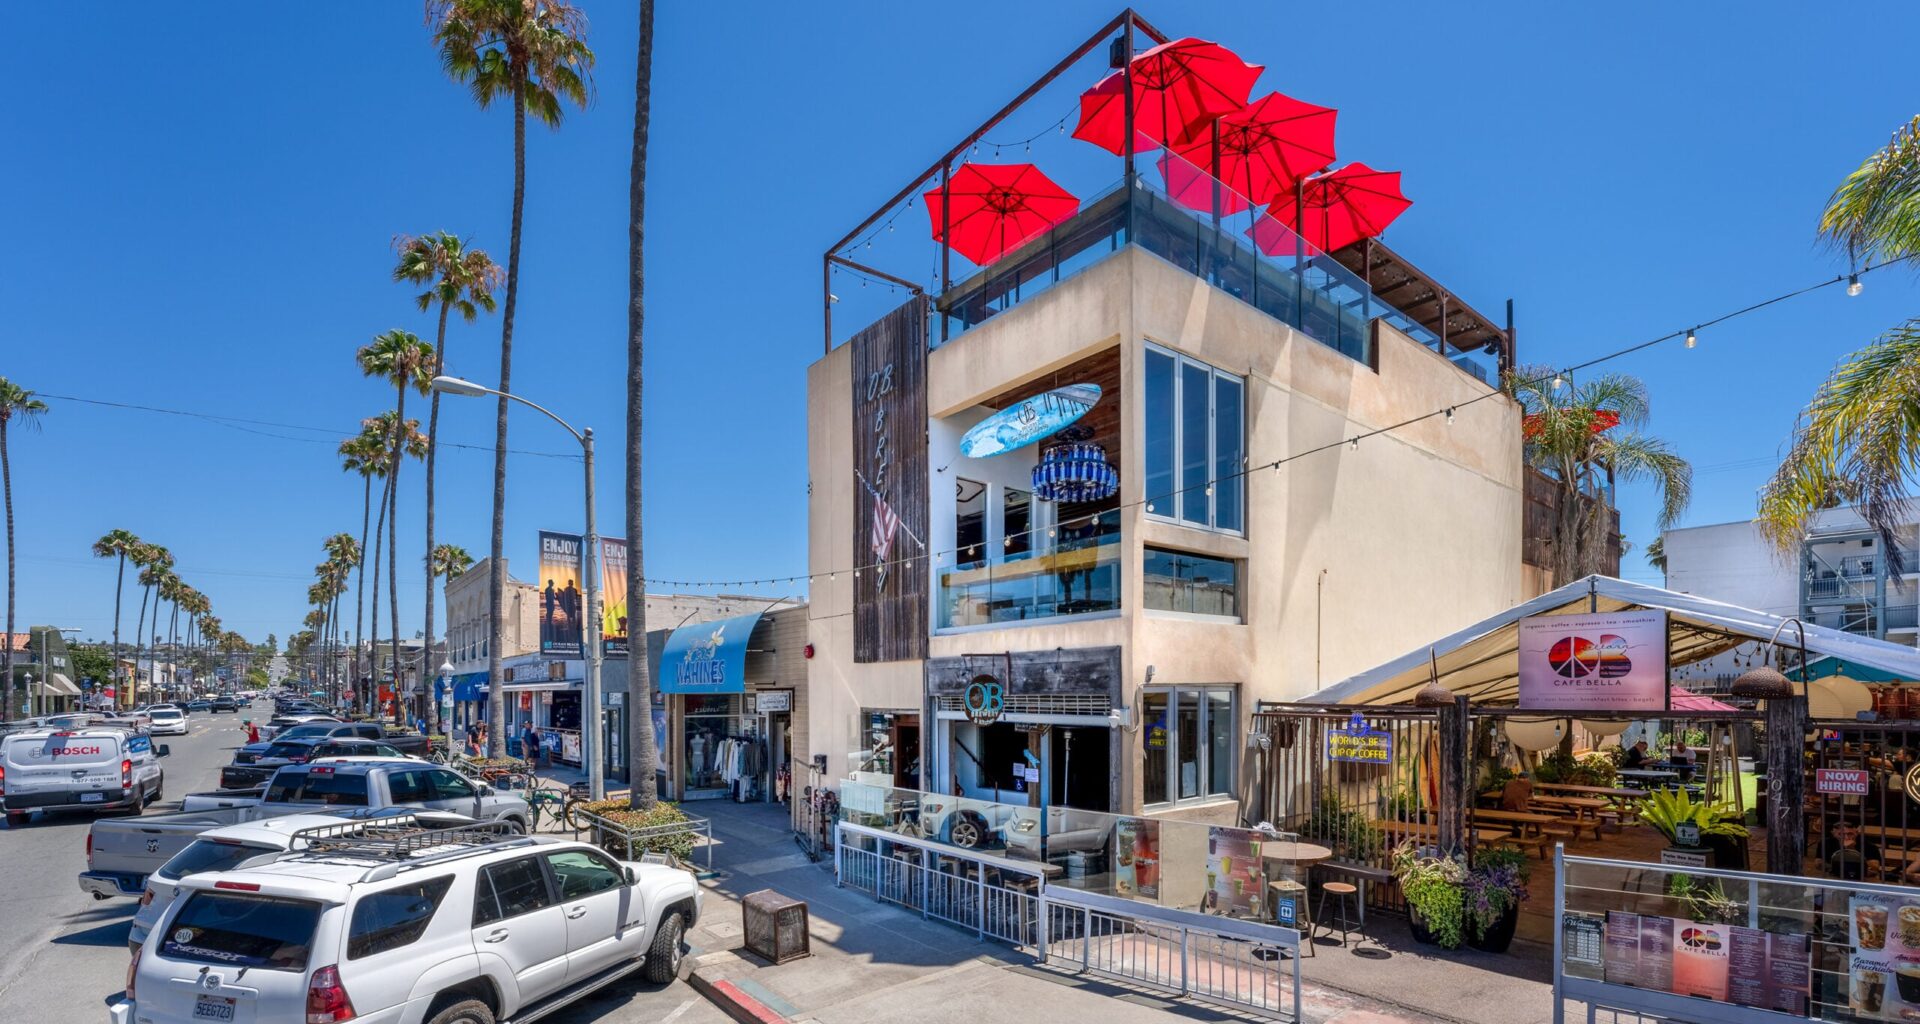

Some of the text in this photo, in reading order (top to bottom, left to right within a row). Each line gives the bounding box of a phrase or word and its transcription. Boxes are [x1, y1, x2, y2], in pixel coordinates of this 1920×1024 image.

[543, 538, 579, 555] ENJOY
[544, 552, 579, 562] OCEAN BEACH
[1622, 617, 1656, 625] smoothies
[676, 659, 725, 685] WAHINES
[1553, 679, 1622, 687] CAFE BELLA
[964, 682, 1004, 713] OB
[1329, 735, 1366, 746] WORD'S
[52, 746, 100, 756] BOSCH
[1329, 748, 1388, 760] CUP OF COFFEE
[1824, 771, 1860, 781] NOW
[1819, 781, 1866, 793] HIRING
[1872, 894, 1895, 903] Coffee
[1677, 945, 1698, 953] CAFE
[1851, 961, 1895, 974] Macchiato
[1853, 956, 1890, 968] Caramel
[195, 1002, 232, 1019] 5EEG723
